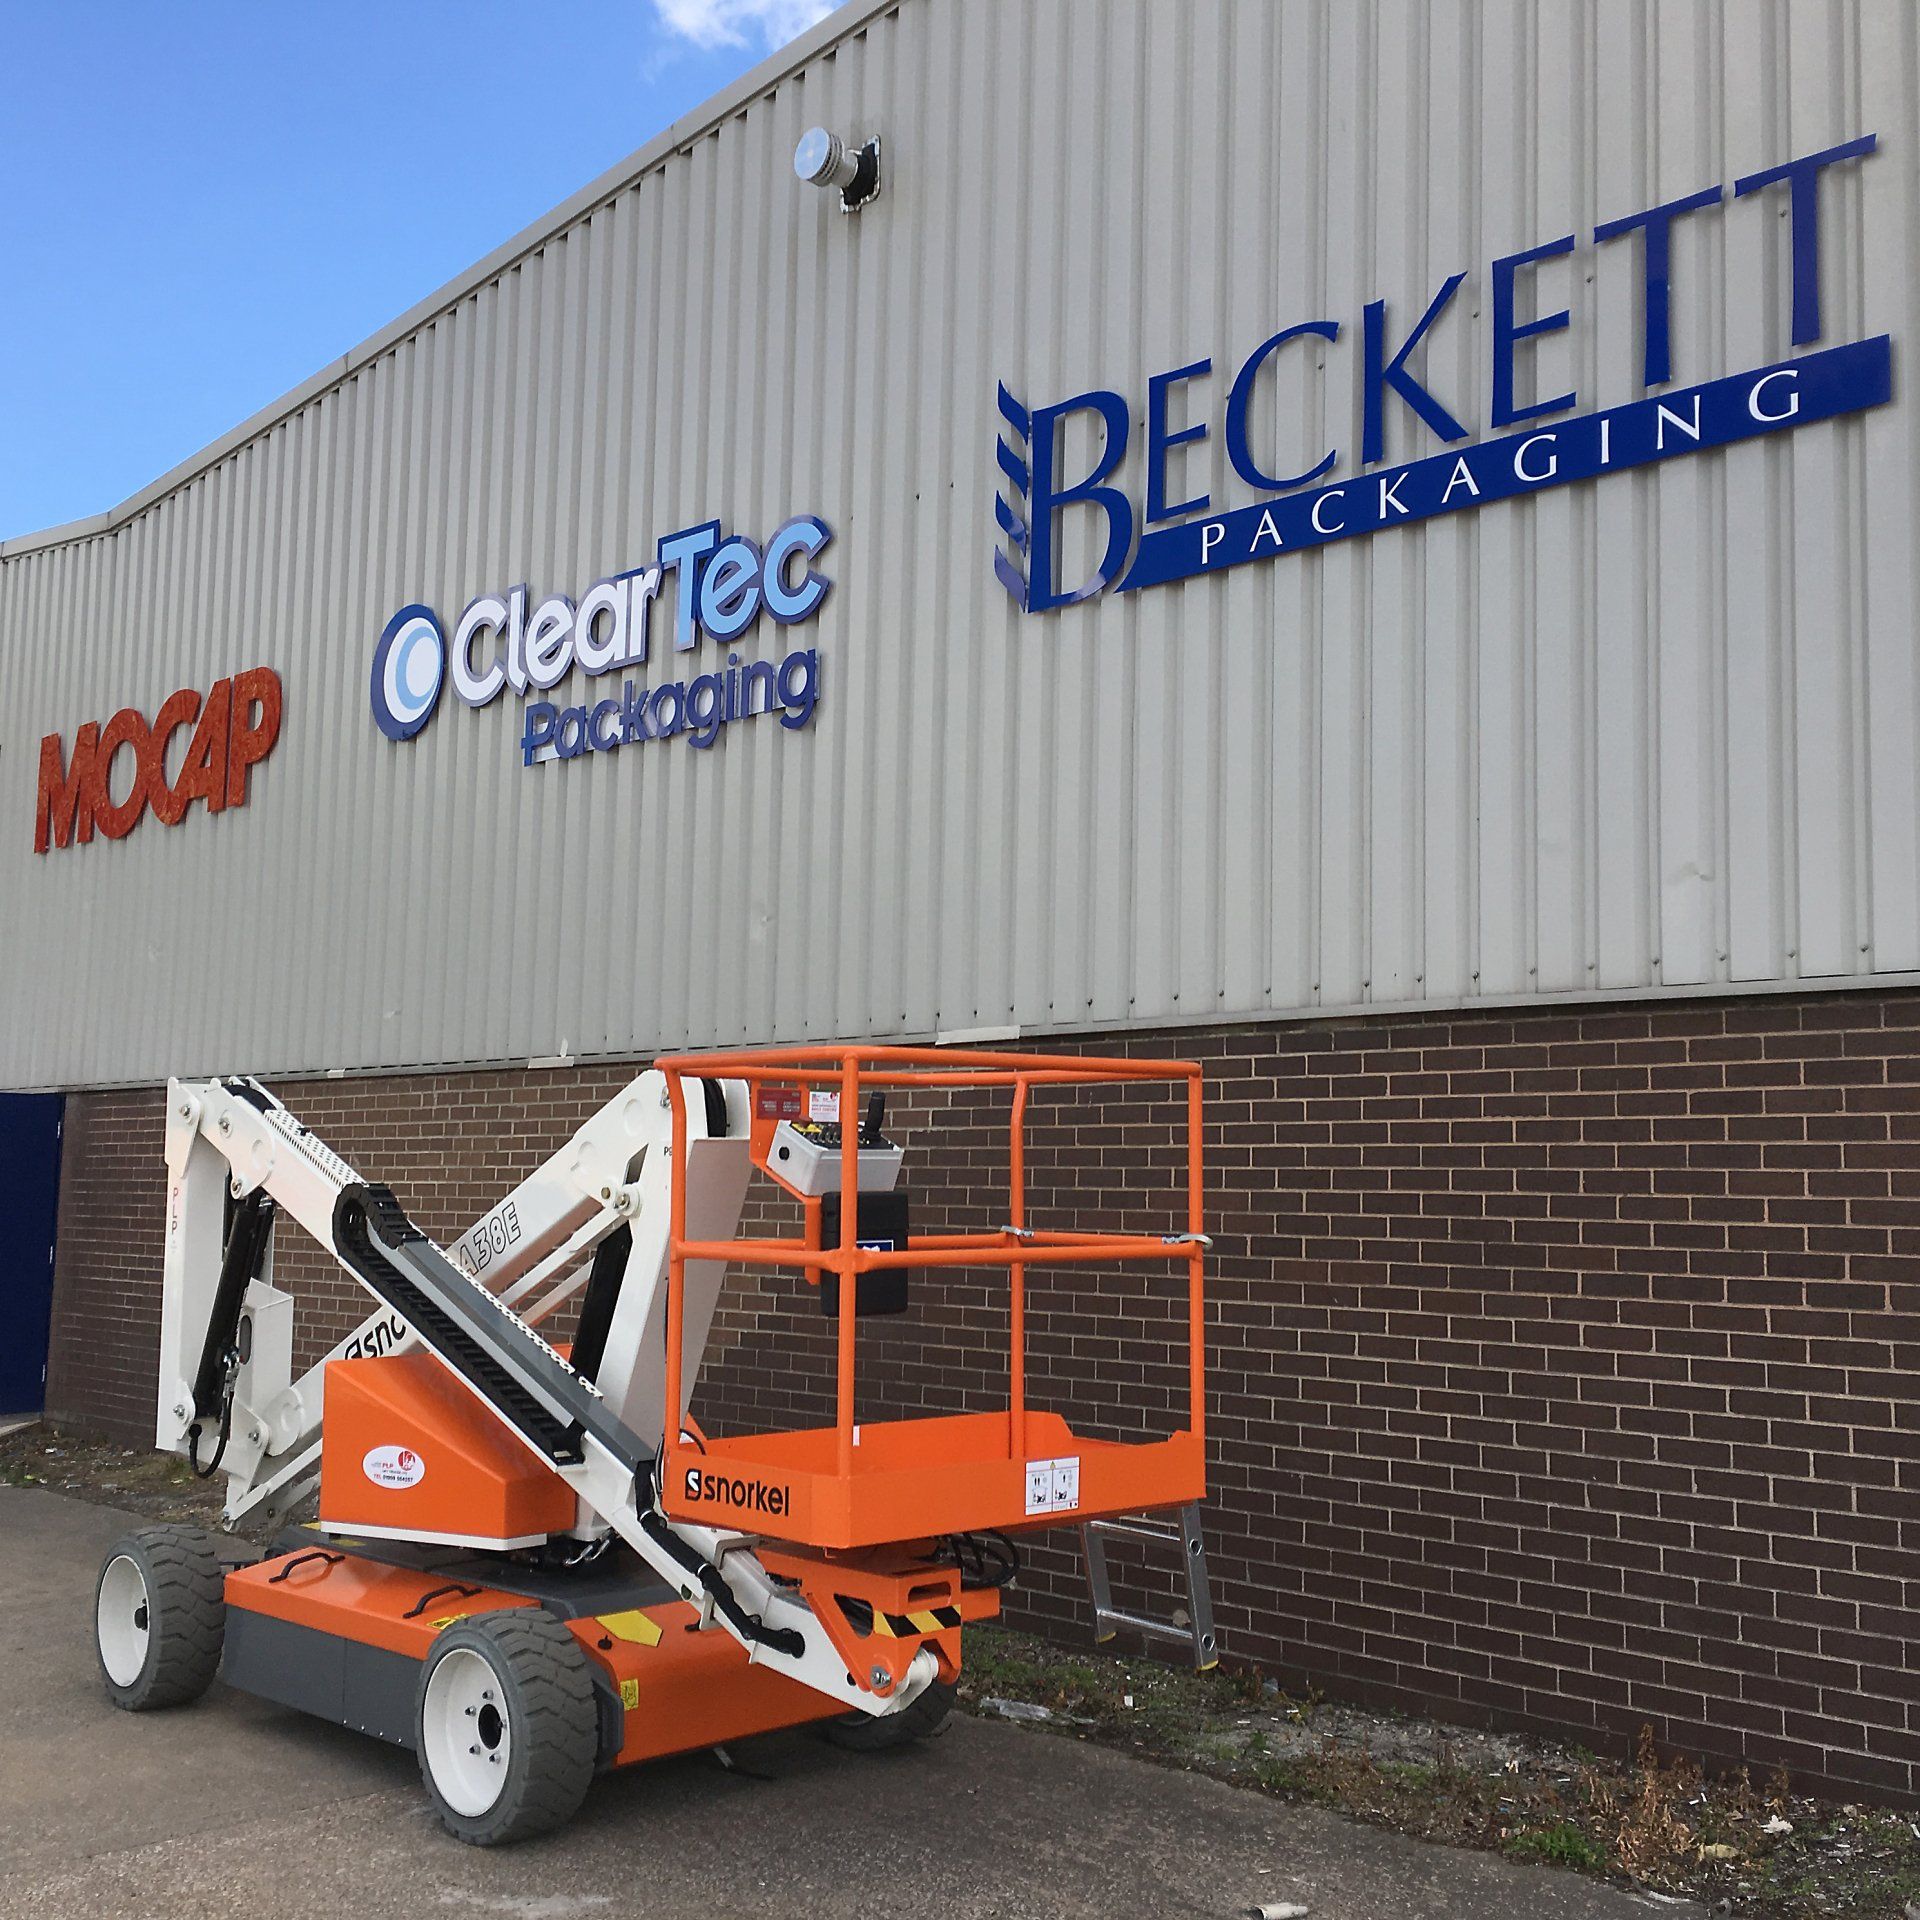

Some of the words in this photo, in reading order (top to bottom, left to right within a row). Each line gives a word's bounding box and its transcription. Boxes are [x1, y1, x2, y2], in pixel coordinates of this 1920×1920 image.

[1028, 133, 1877, 614] BECKETT
[1201, 369, 1801, 565] PACKAGING
[451, 514, 833, 707] ClearTec
[34, 666, 282, 854] MOCAP
[521, 648, 817, 768] Packaging
[458, 1201, 522, 1277] A38E
[704, 1475, 790, 1517] snorkel
